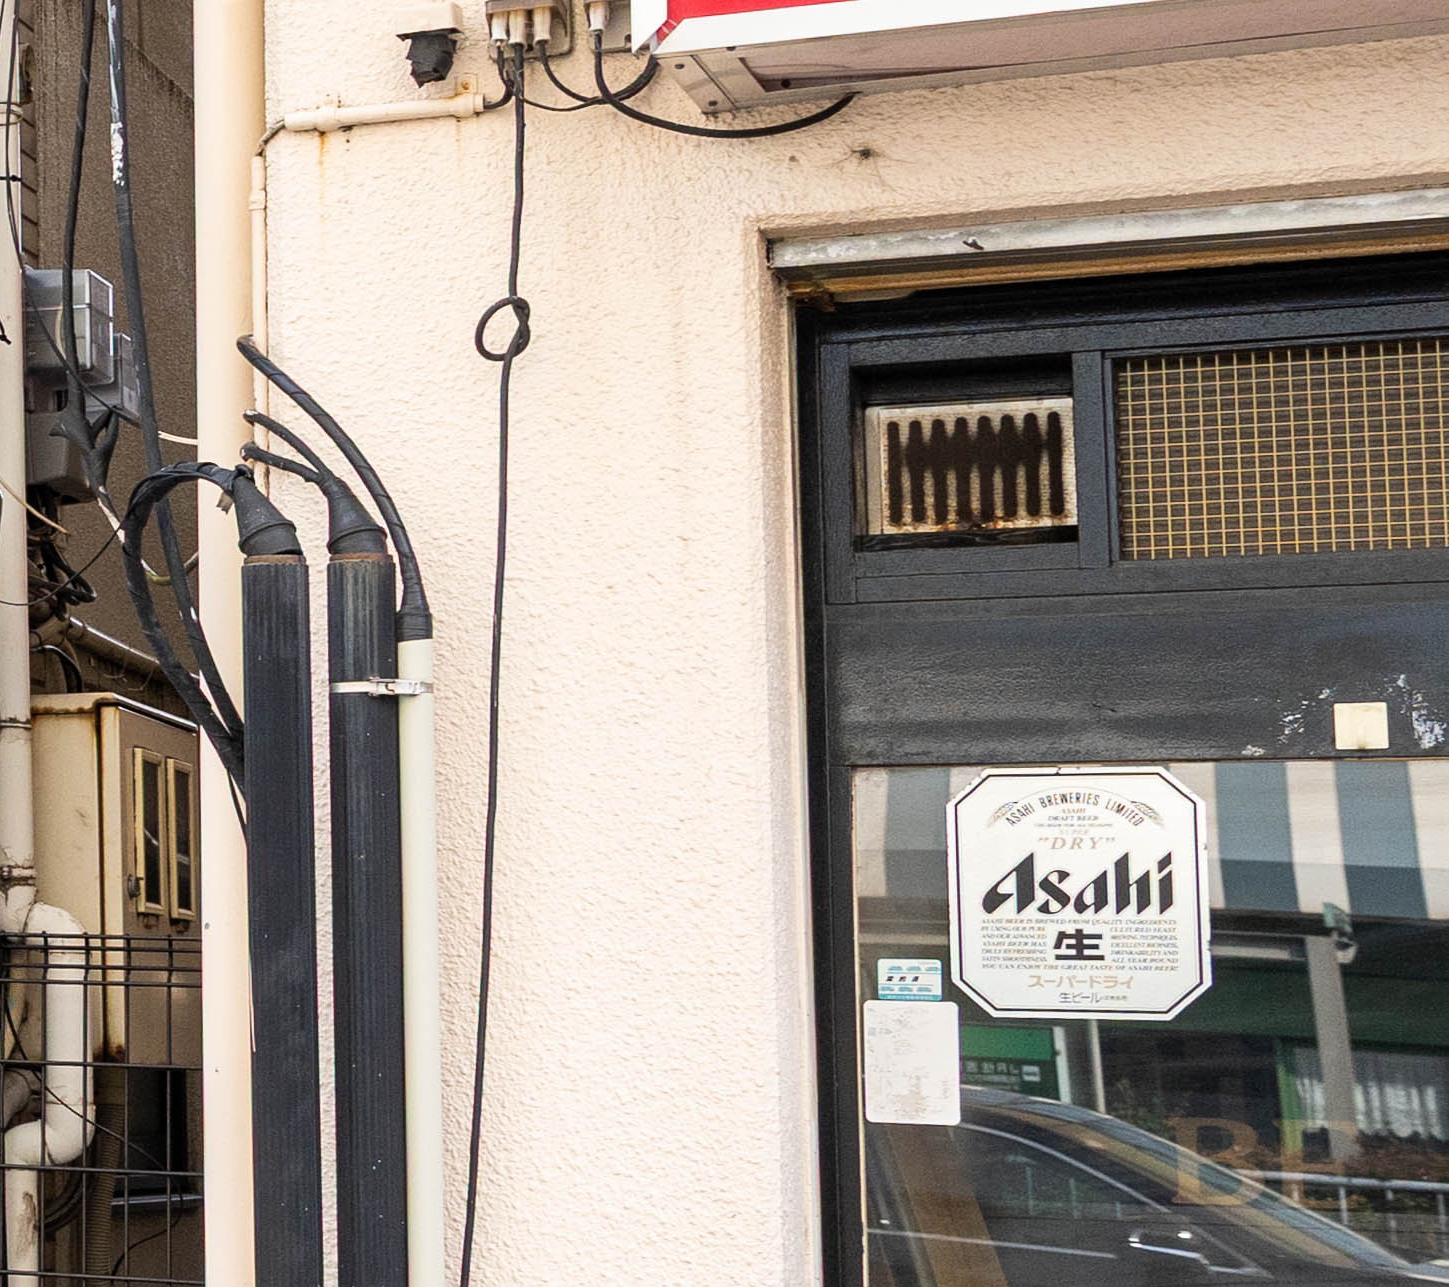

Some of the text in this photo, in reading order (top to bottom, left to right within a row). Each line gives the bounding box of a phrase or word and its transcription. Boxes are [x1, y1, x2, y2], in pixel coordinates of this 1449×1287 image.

[1005, 792, 1144, 827] ASAHI BREWERIES LIMITED
[982, 851, 1174, 915] Asahi
[1053, 928, 1105, 961] 生
[1027, 975, 1134, 989] スーパードライ
[1059, 992, 1101, 1004] 生ビール
